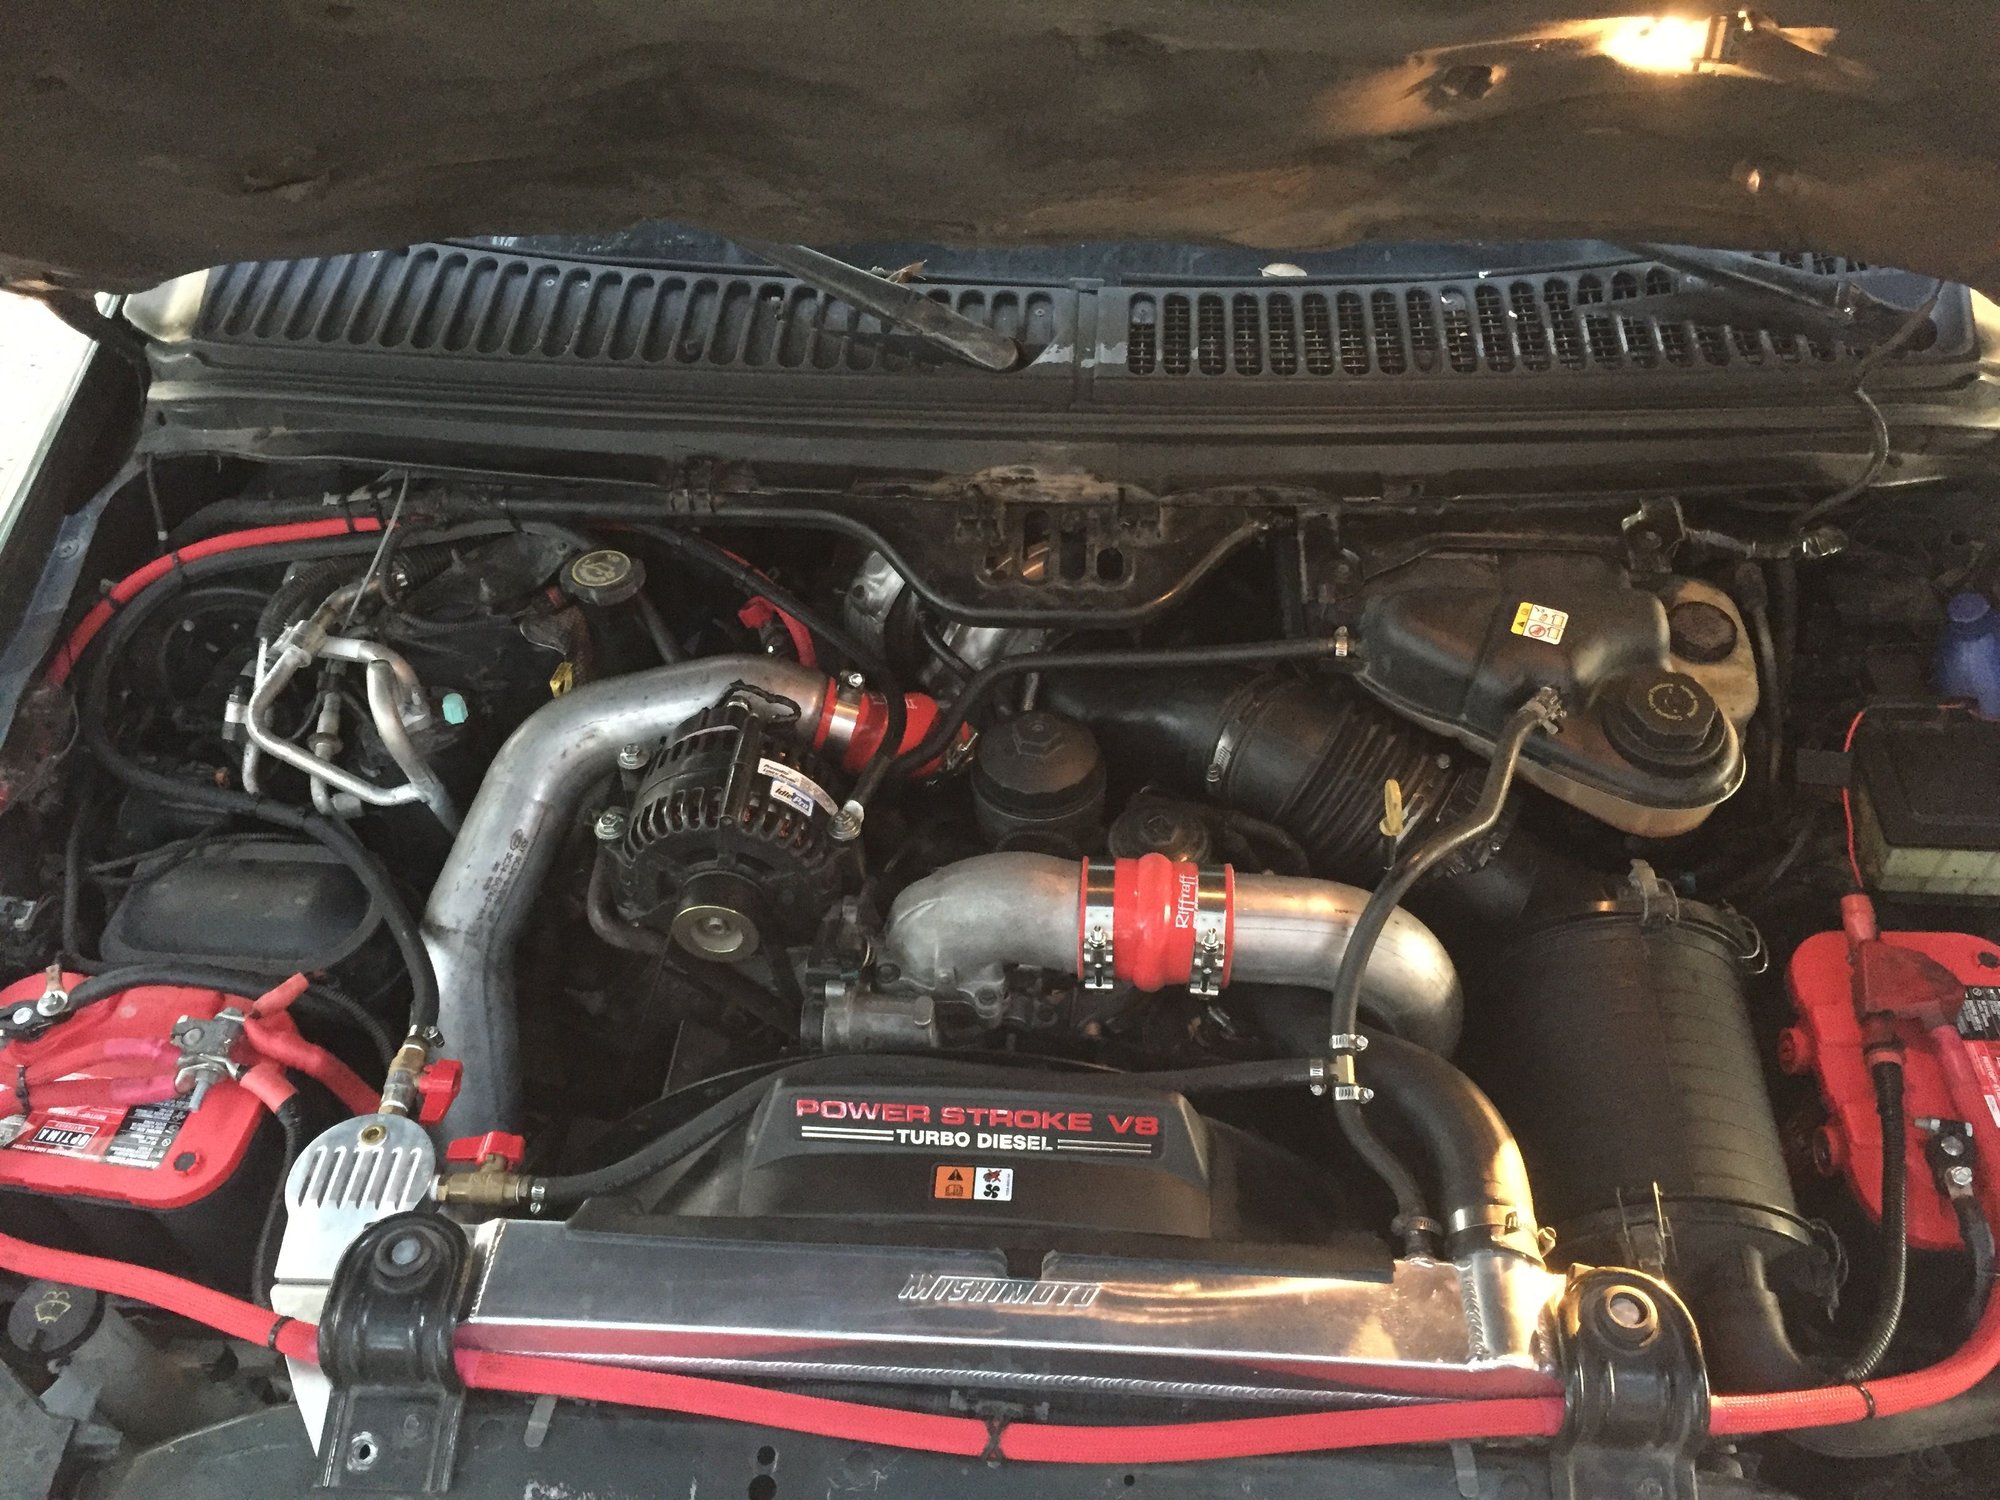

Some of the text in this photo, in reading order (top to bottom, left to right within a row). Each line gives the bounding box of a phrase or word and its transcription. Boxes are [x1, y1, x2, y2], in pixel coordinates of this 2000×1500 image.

[1175, 873, 1196, 929] Riffraff
[796, 1099, 1159, 1136] POWER STROKE V8
[37, 1127, 92, 1146] OPTIMA
[896, 1129, 1053, 1151] TURBO DIESEL
[898, 1274, 1101, 1308] MISHIMOTO
